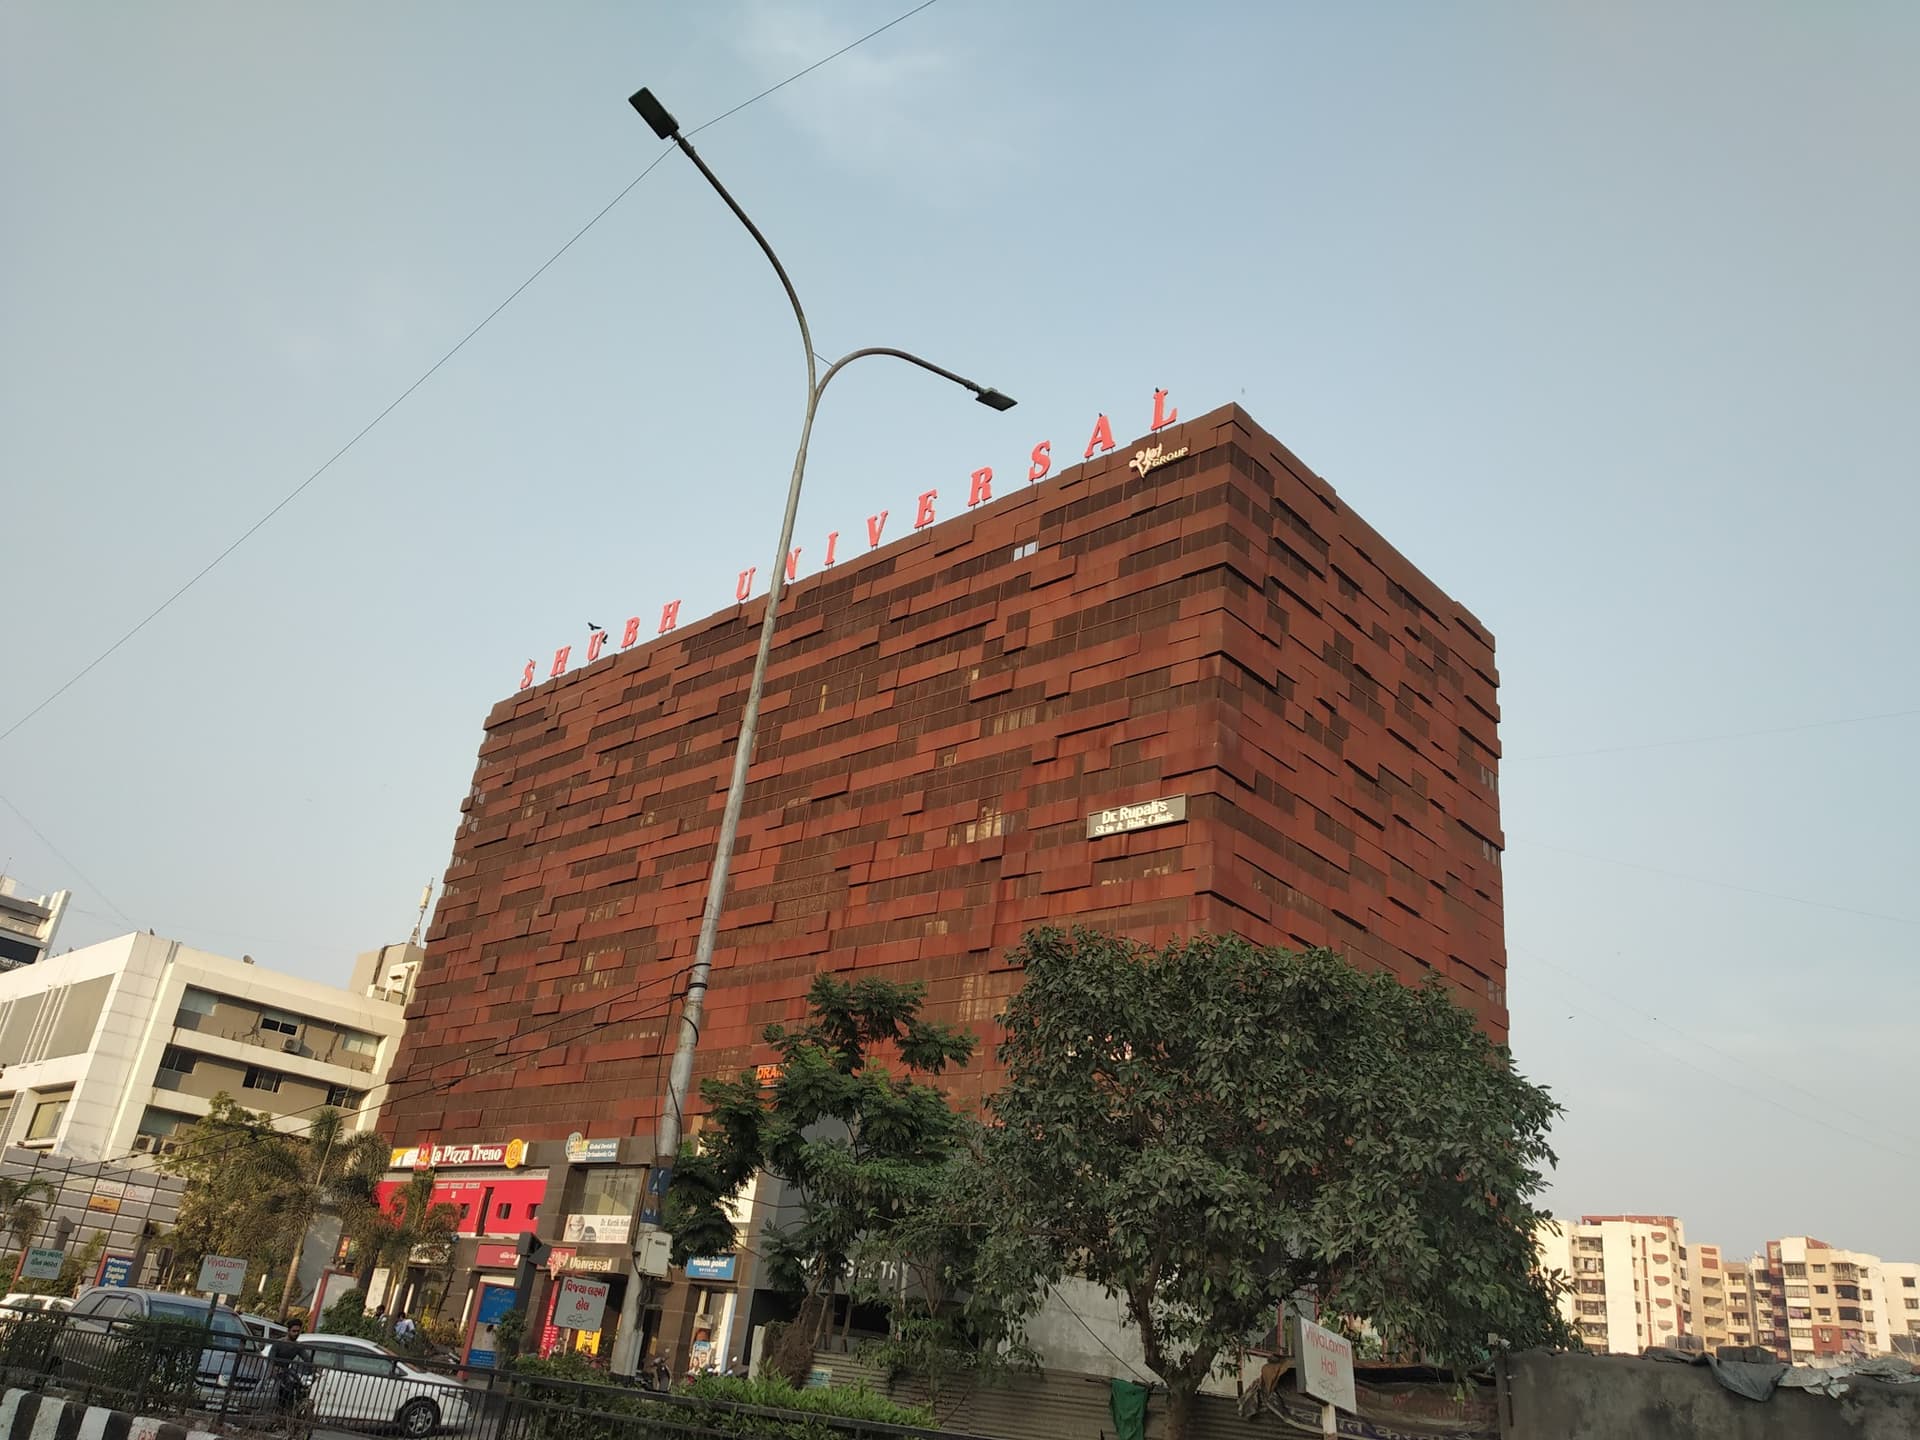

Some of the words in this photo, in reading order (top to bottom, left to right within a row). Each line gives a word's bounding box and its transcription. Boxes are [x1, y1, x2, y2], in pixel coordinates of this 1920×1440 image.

[1152, 447, 1189, 467] GROUP
[520, 600, 681, 689] SHUBH
[736, 388, 1178, 602] UNIVERSAL
[1120, 800, 1168, 821] Rupali's
[1095, 825, 1114, 835] Skin
[1127, 819, 1147, 829] Hair
[1148, 812, 1175, 824] Clinic
[442, 1145, 470, 1163] Pizza
[471, 1144, 502, 1161] Treno
[569, 1257, 612, 1271] Universal
[710, 1260, 727, 1269] point
[105, 1272, 125, 1280] English
[1320, 1355, 1338, 1377] Hall
